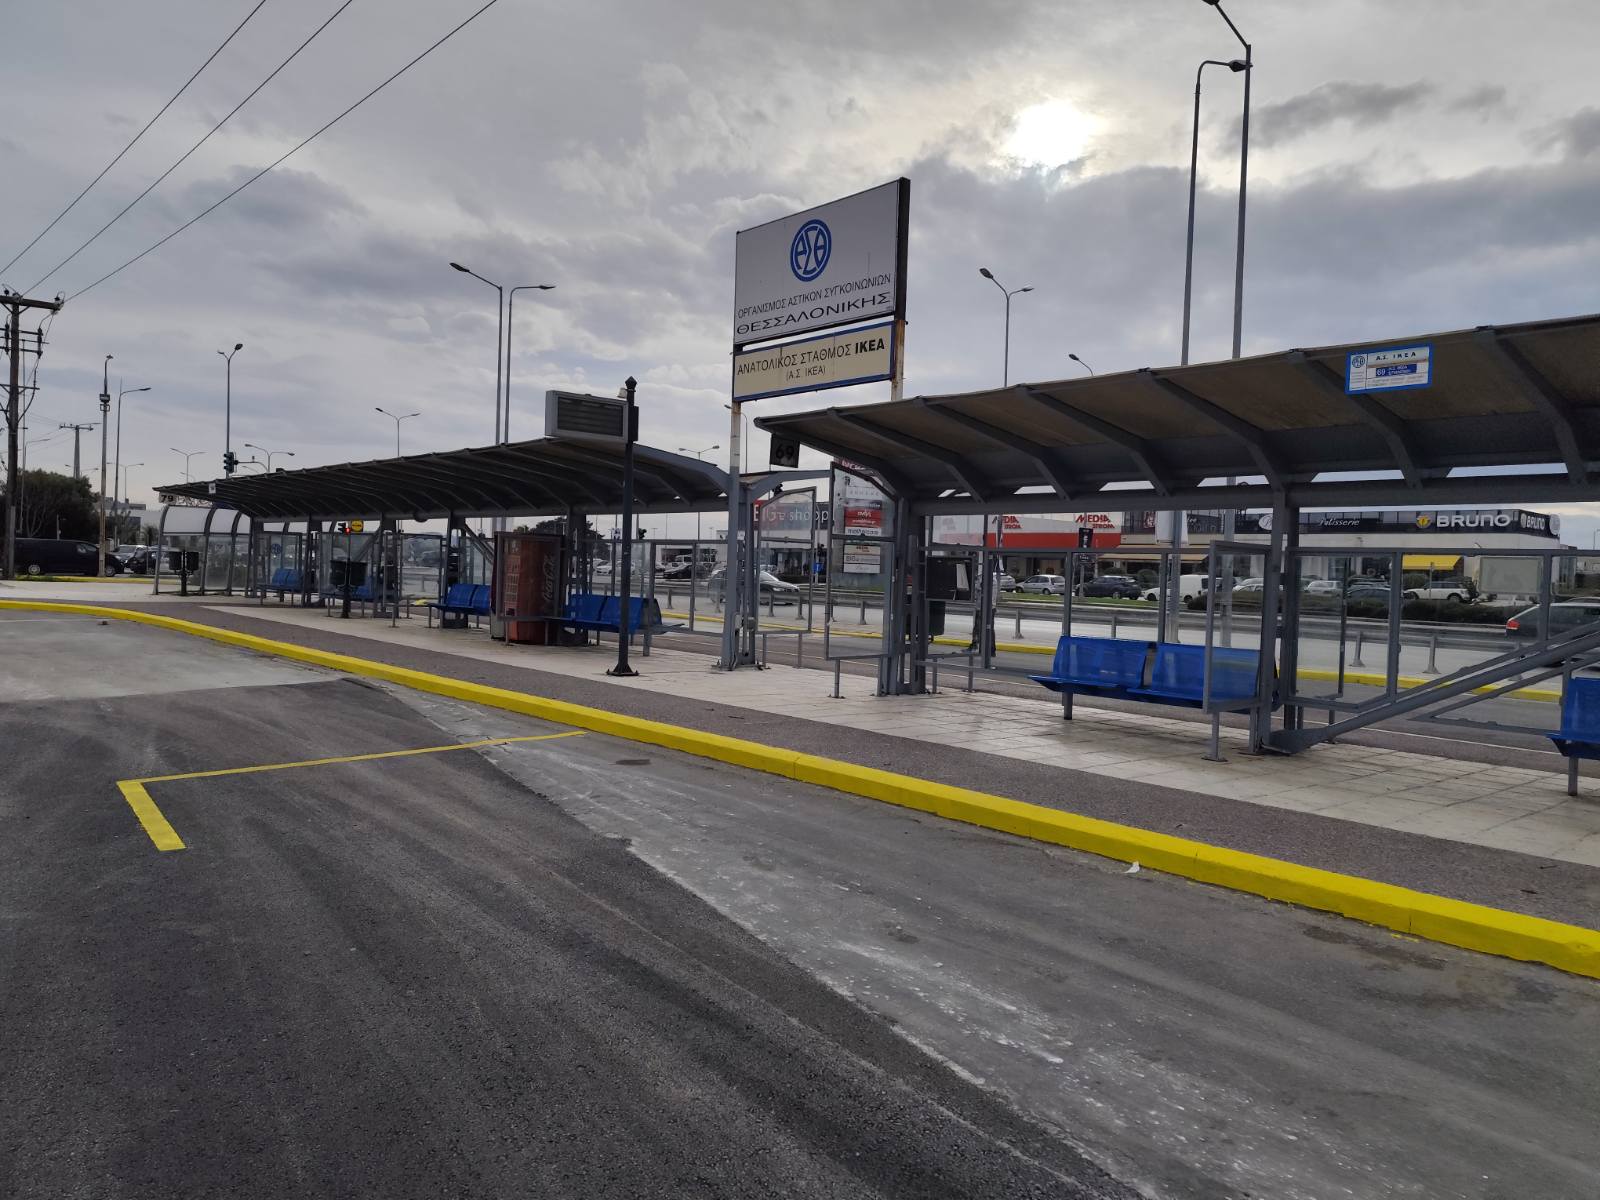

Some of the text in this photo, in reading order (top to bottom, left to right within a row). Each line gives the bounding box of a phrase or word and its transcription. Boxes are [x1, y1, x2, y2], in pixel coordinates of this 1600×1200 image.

[736, 291, 891, 335] ΘΕΣΣΑΛΟΝΙΚΗΣ
[737, 298, 787, 319] ΟΡΓΑΝΙΣΜΟΣ
[737, 353, 798, 376] ΑΝΑΤΟΛΙΚΟΣ
[800, 343, 852, 365] ΣΤΑΘΜΟΣ
[776, 445, 794, 460] 69
[1075, 513, 1111, 524] MEDIA
